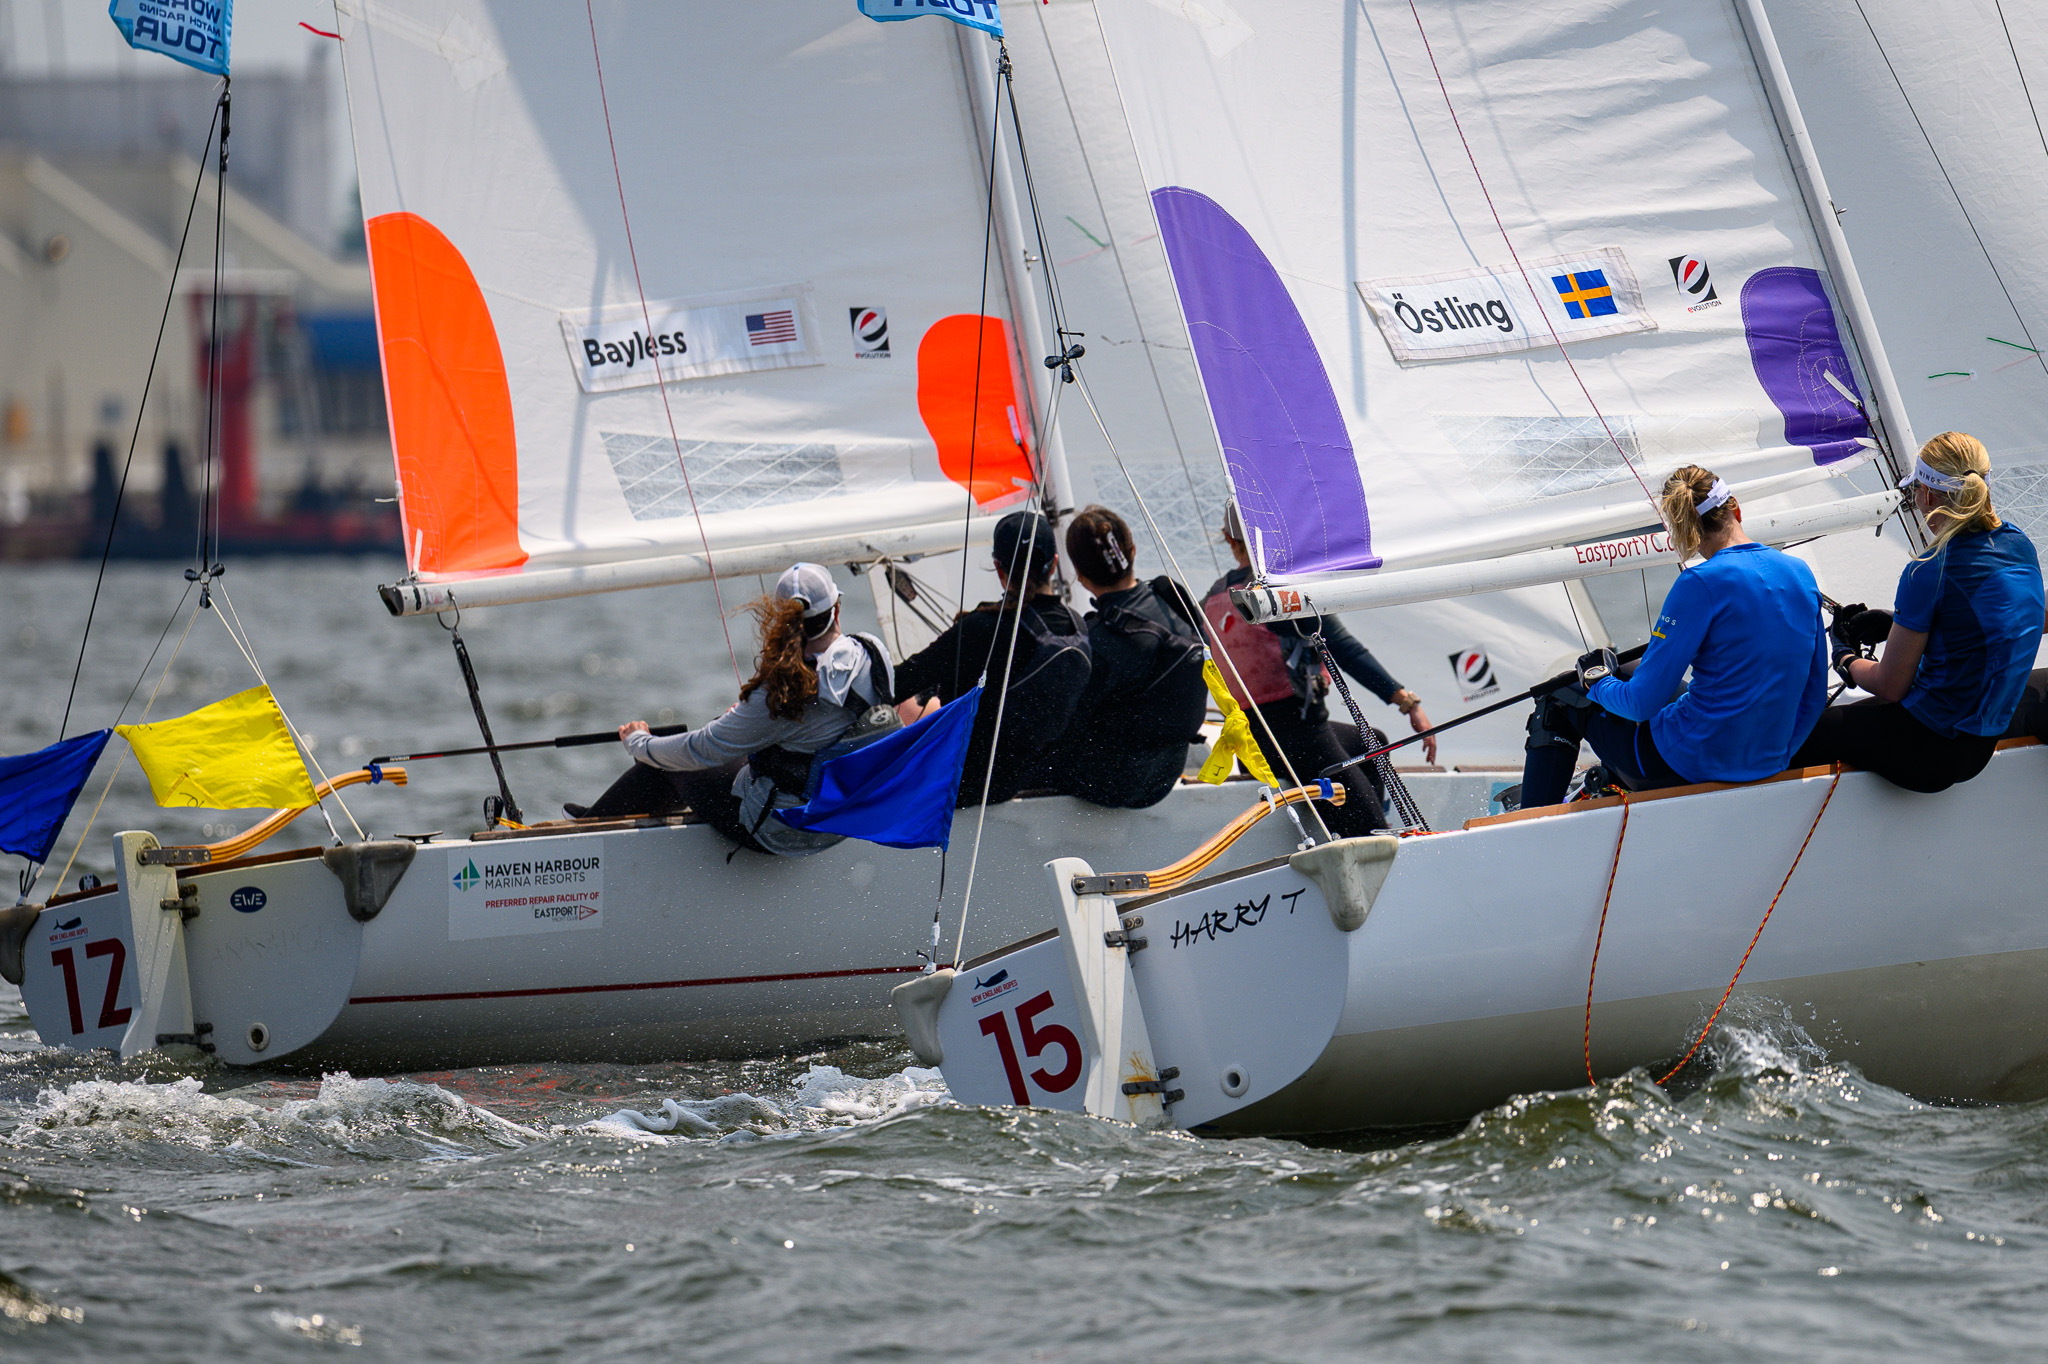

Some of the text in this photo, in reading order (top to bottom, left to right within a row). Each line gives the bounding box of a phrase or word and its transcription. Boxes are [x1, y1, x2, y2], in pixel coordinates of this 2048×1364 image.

[1392, 292, 1514, 334] Östling
[583, 330, 688, 368] Bayless
[485, 857, 600, 878] HAVEN HARBOUR
[485, 872, 586, 890] MARINA RESORTS
[234, 893, 263, 907] EWE
[485, 891, 600, 909] PREFERRED REPAIR FACILITY OF
[534, 905, 579, 919] EASTPORT
[1170, 888, 1306, 949] HARRY T
[58, 930, 76, 941] ENGLAND
[76, 927, 89, 937] ROPES
[51, 937, 133, 1035] 12
[971, 979, 1018, 1004] NEW ENGLAND ROPES
[978, 990, 1083, 1106] 15
